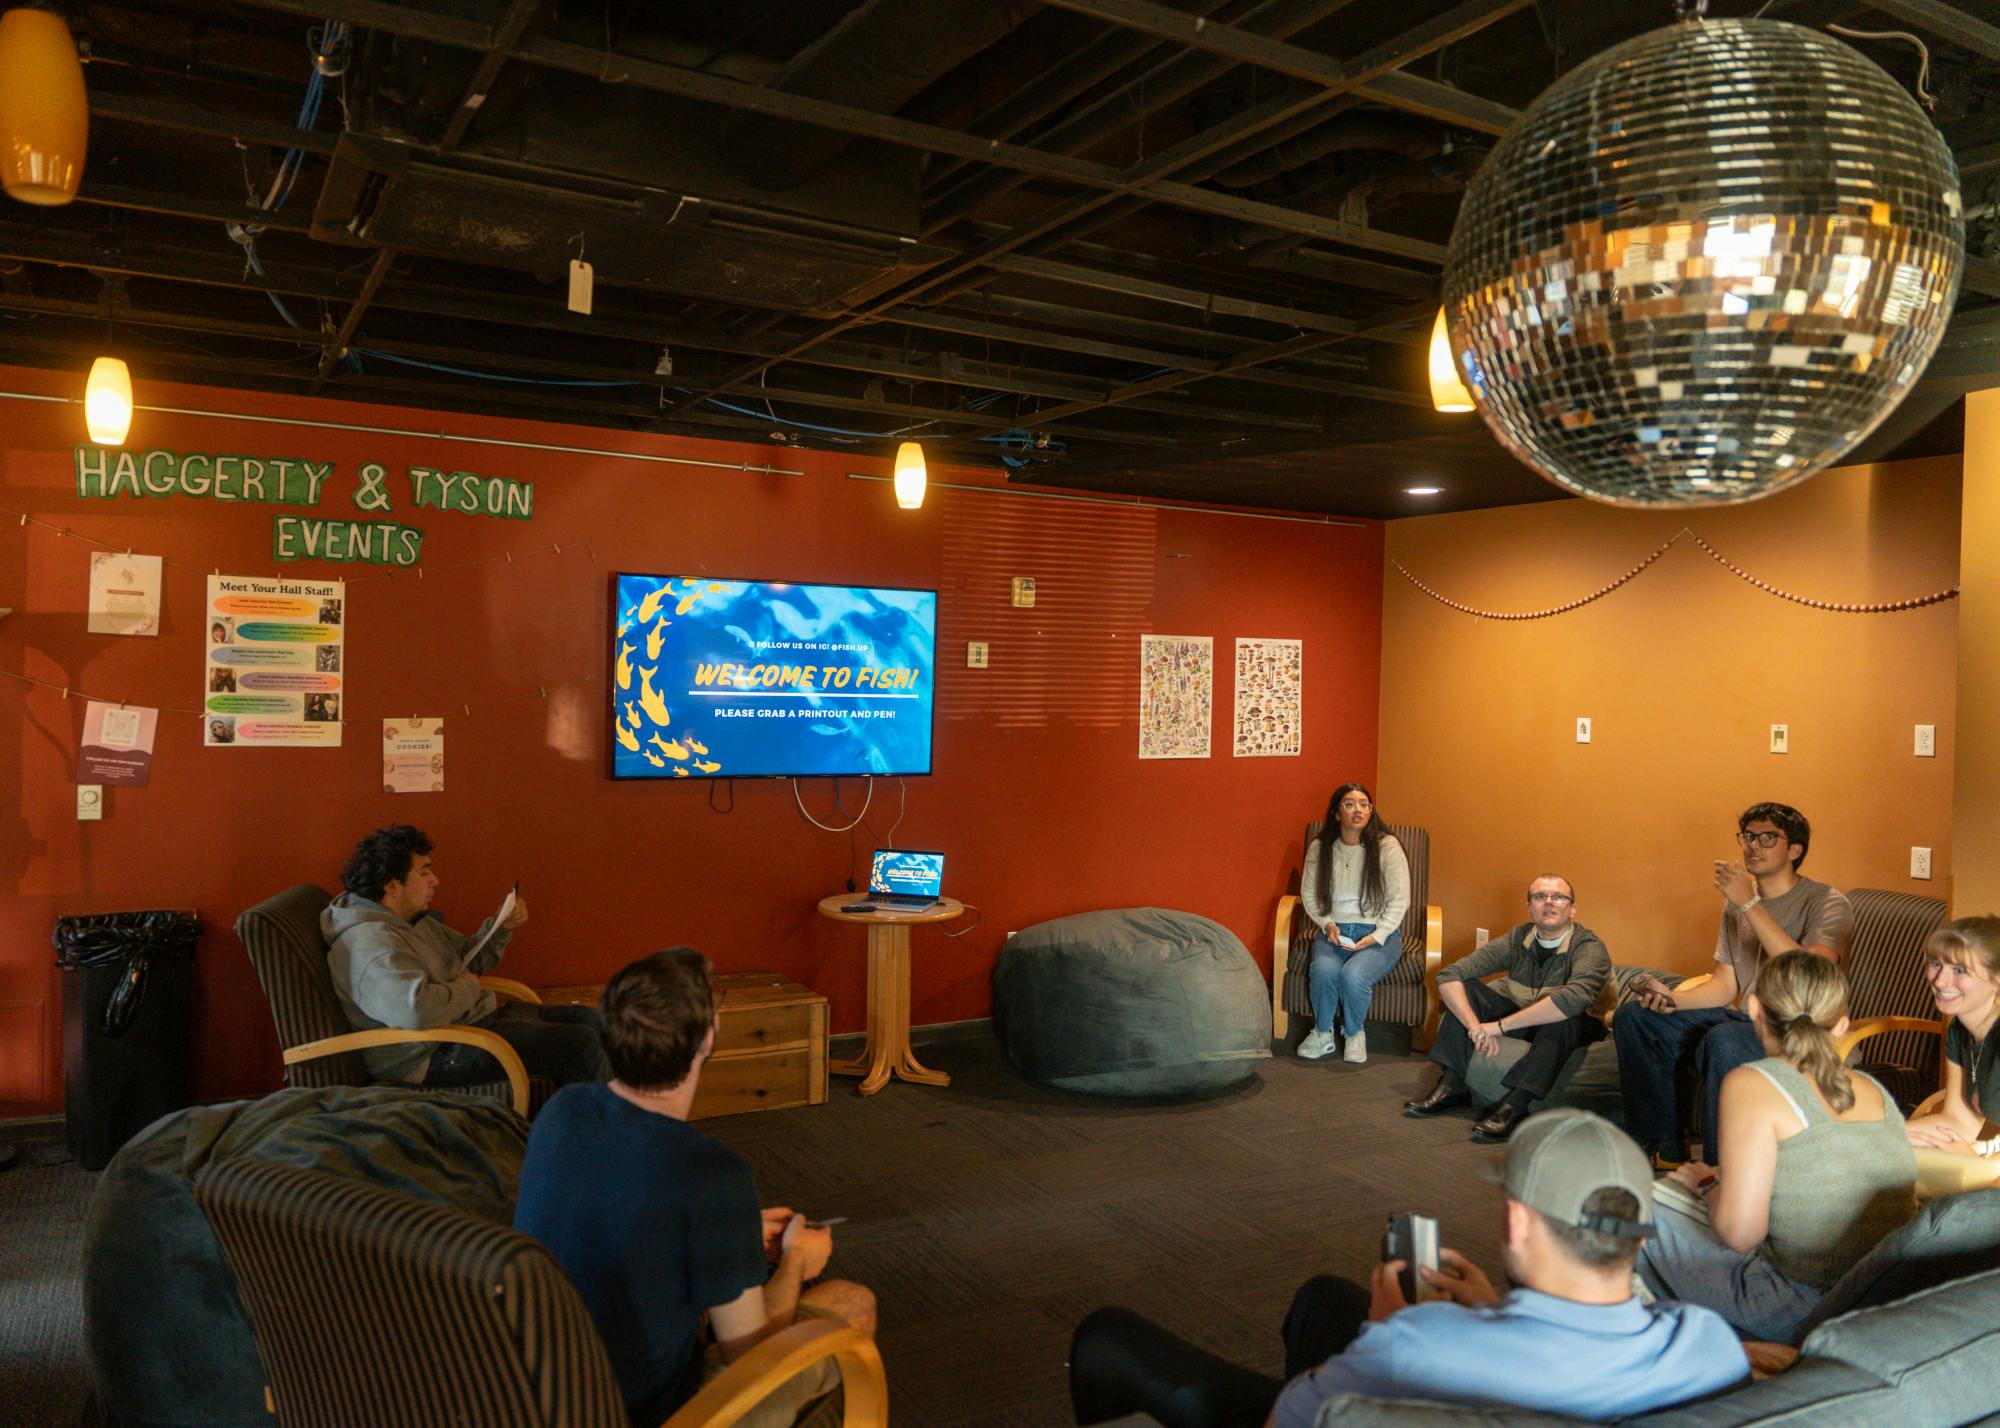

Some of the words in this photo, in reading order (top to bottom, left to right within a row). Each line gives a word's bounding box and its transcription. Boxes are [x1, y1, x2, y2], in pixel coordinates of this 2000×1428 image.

[78, 447, 330, 504] HAGGERTY
[354, 463, 392, 511] &
[410, 469, 531, 516] TYSON
[277, 517, 420, 566] EVENTS
[220, 582, 247, 592] Meet
[251, 583, 277, 593] Your
[280, 585, 302, 595] Hall
[305, 586, 334, 596] Staff!
[756, 641, 790, 649] FOLLOW
[695, 663, 816, 687] WELCOME
[822, 667, 851, 688] TO
[855, 668, 920, 689] FISH!
[714, 709, 755, 718] PLEASE
[757, 709, 786, 718] GRAB
[788, 710, 796, 718] A
[798, 710, 848, 718] PRINTOUT
[850, 710, 872, 719] AND
[873, 711, 896, 719] PEN!
